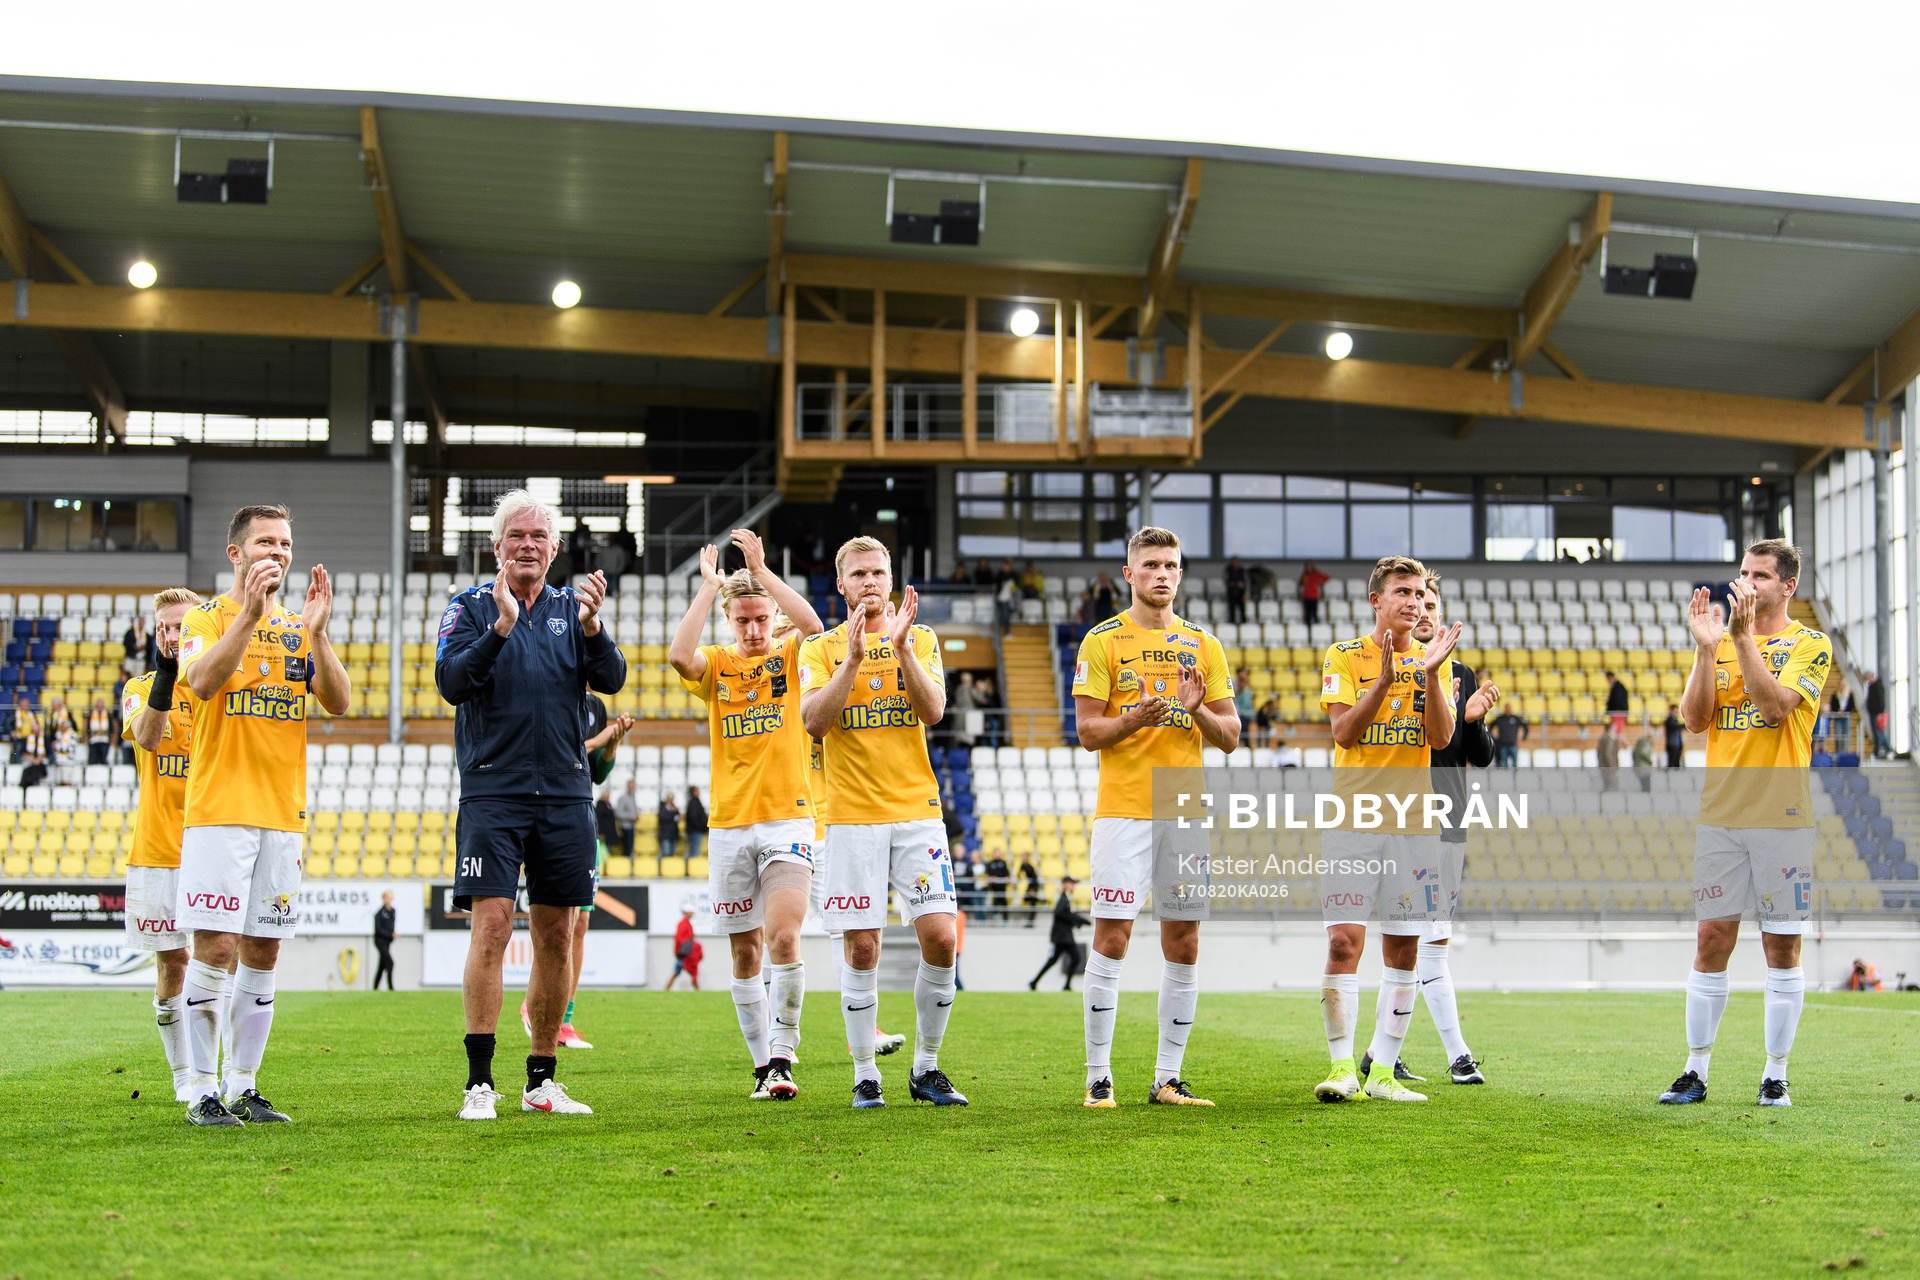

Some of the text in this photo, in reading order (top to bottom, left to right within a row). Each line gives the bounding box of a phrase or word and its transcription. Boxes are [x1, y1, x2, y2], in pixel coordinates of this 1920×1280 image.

[1142, 650, 1177, 662] FBG
[256, 683, 294, 702] Gekås
[744, 702, 782, 719] Gekås
[871, 695, 907, 712] Gekås
[1389, 715, 1422, 729] Gekås
[461, 857, 482, 877] SN
